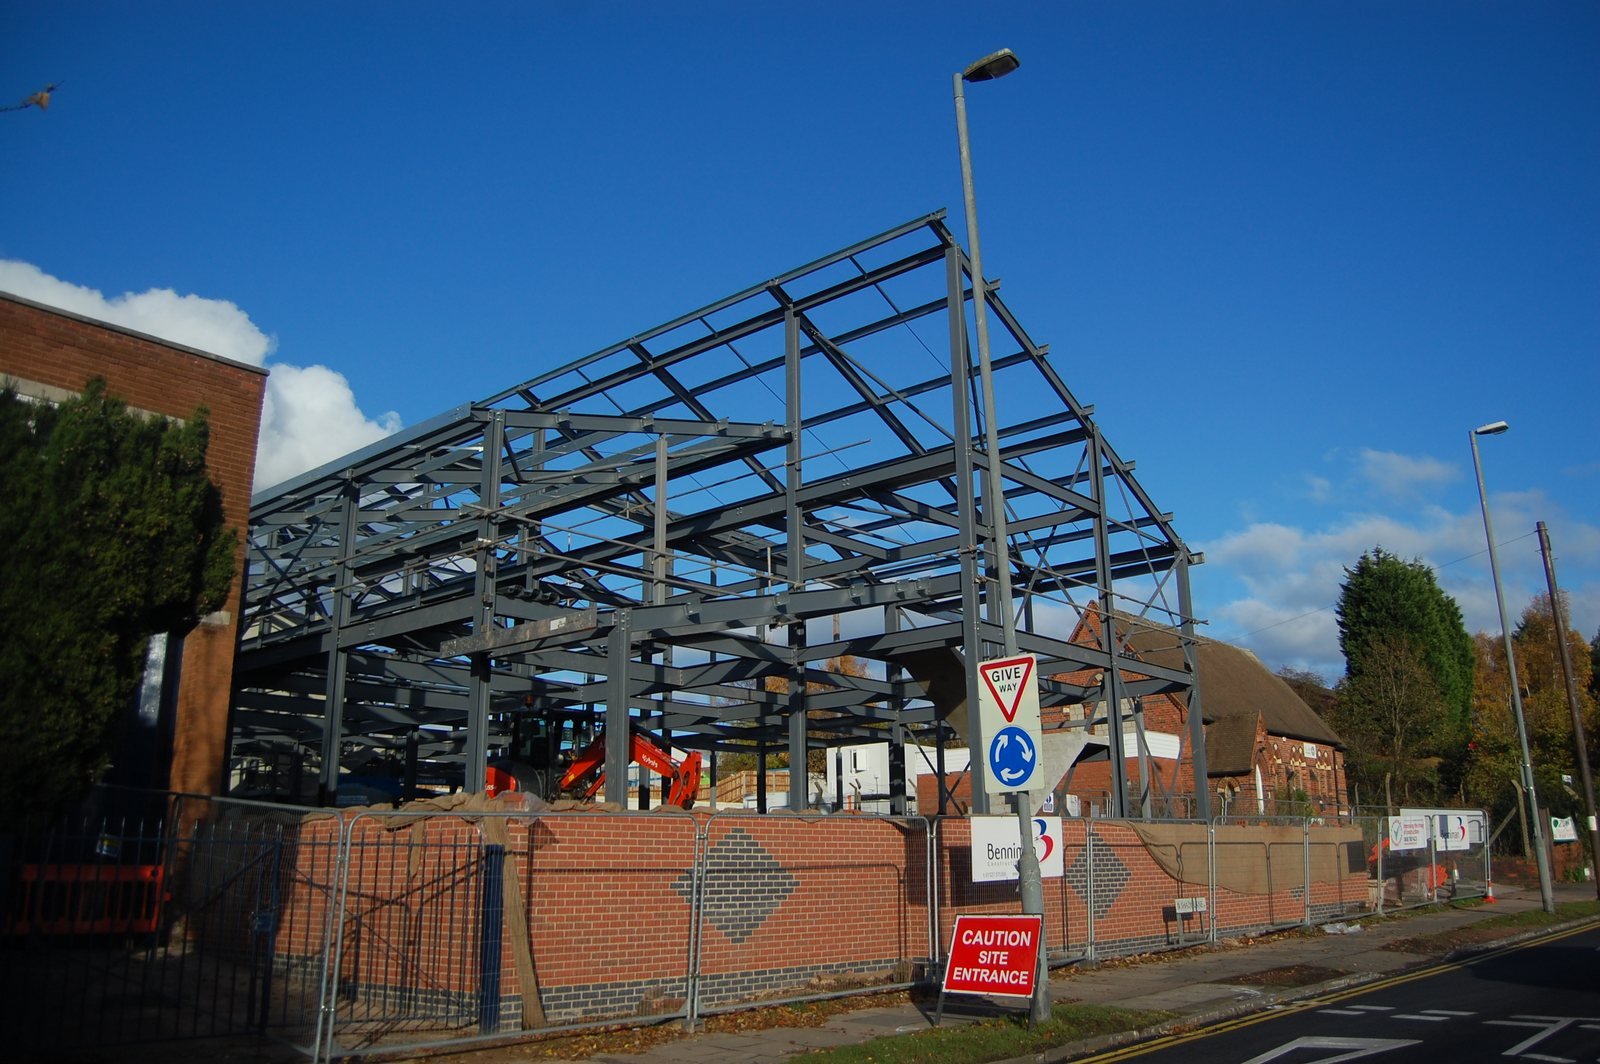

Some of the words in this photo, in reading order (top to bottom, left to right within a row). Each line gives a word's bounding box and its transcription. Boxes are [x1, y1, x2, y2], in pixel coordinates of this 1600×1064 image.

[992, 667, 1021, 682] GIVE
[999, 683, 1017, 693] WAY
[962, 930, 1031, 947] CAUTION
[978, 951, 1009, 965] SITE
[952, 967, 1029, 985] ENTRANCE
